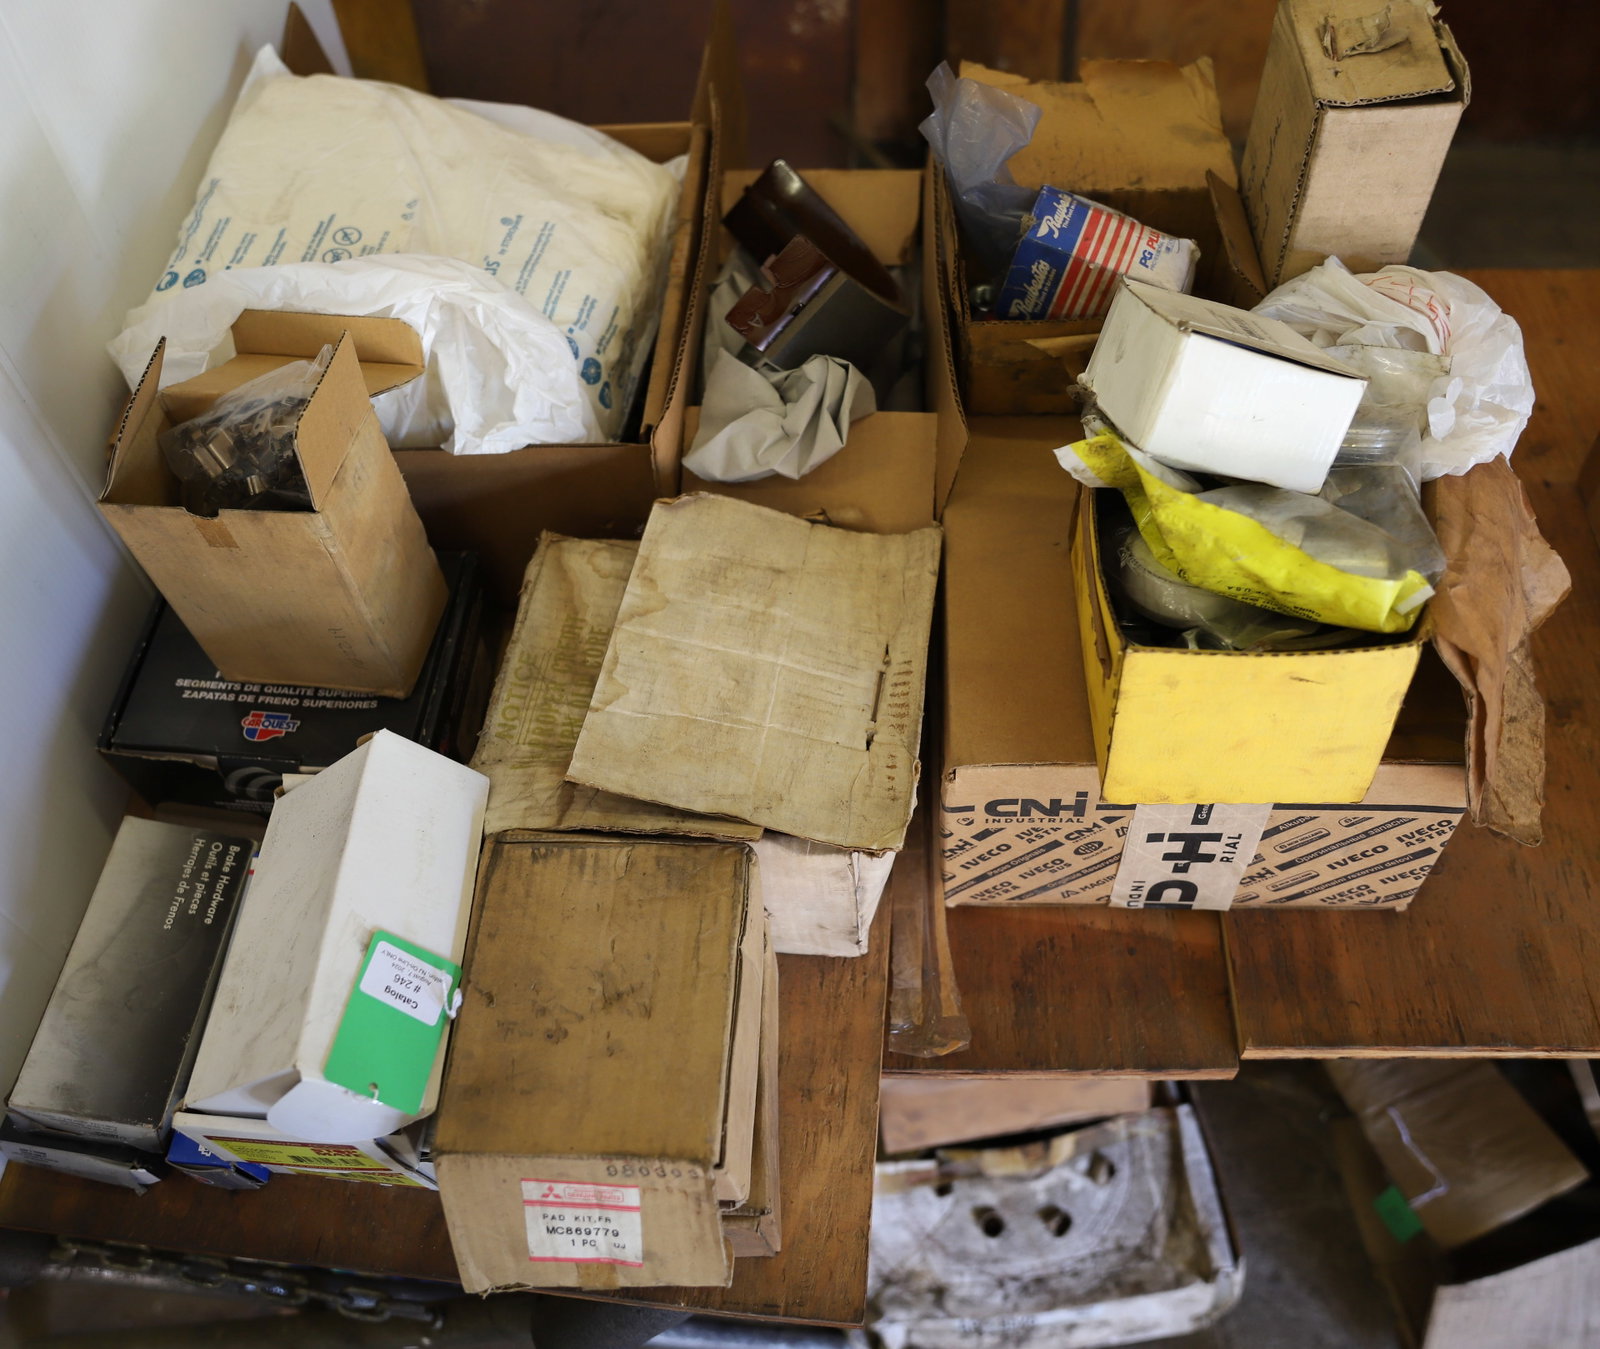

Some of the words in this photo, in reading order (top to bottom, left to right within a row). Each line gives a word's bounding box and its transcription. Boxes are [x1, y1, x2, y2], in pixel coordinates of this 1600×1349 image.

[1139, 249, 1153, 269] PG
[1009, 259, 1051, 320] Raybestos
[551, 614, 587, 676] CREDIT
[585, 627, 611, 670] CORE
[175, 678, 241, 691] SEGMENTS
[244, 684, 260, 693] DE
[495, 651, 538, 740] NOTICE
[181, 690, 235, 701] ZAPATAS
[238, 694, 256, 703] DE
[257, 695, 300, 706] FRENO
[302, 700, 378, 709] SUPERIORES
[241, 717, 300, 732] CARQUEST
[984, 791, 1089, 817] CNH
[1396, 819, 1453, 843] IVECO
[182, 838, 206, 879] Herrajes
[205, 842, 223, 870] Outils
[222, 845, 241, 872] Brake
[959, 843, 1012, 870] IVECO
[1327, 844, 1389, 870] IVECO
[201, 871, 210, 881] et
[1018, 857, 1065, 879] IVECO
[1048, 862, 1073, 874] BUS
[1379, 864, 1434, 885] IVECO
[176, 881, 190, 893] de
[969, 880, 1014, 900] IVECO
[1320, 884, 1370, 903] IVECO
[204, 875, 231, 925] Hardware
[163, 897, 185, 930] Frenos
[393, 973, 413, 989] 246
[413, 985, 422, 993] #
[384, 985, 418, 1009] Catalog
[542, 1213, 566, 1221] PAD
[571, 1239, 576, 1247] 1
[582, 1239, 597, 1248] PC
